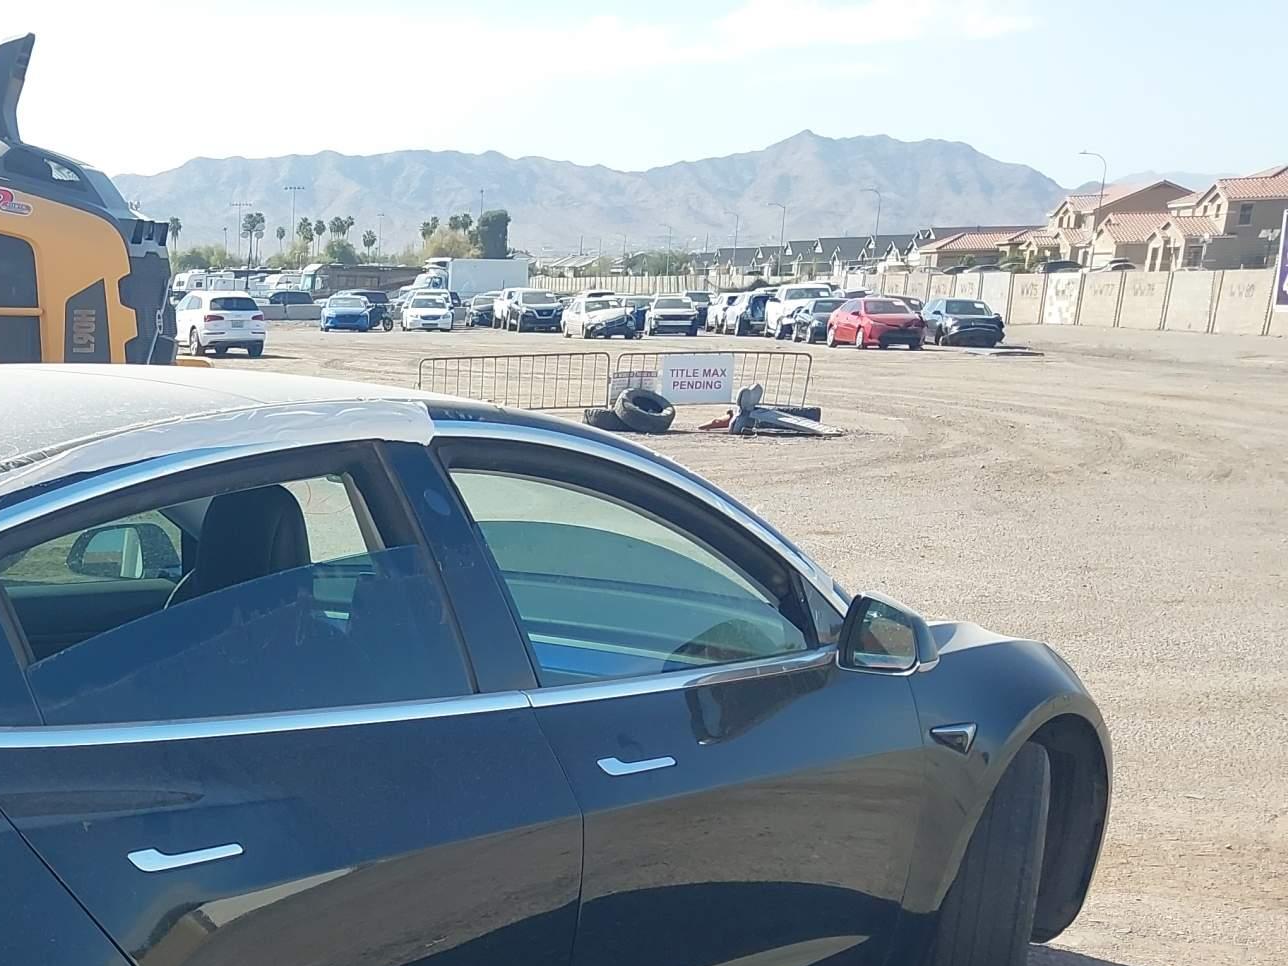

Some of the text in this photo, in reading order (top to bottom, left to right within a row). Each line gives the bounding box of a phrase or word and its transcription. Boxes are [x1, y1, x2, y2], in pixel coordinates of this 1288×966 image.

[73, 309, 96, 353] L90H
[669, 368, 727, 378] TITLE MAX
[672, 380, 722, 390] PENDING
